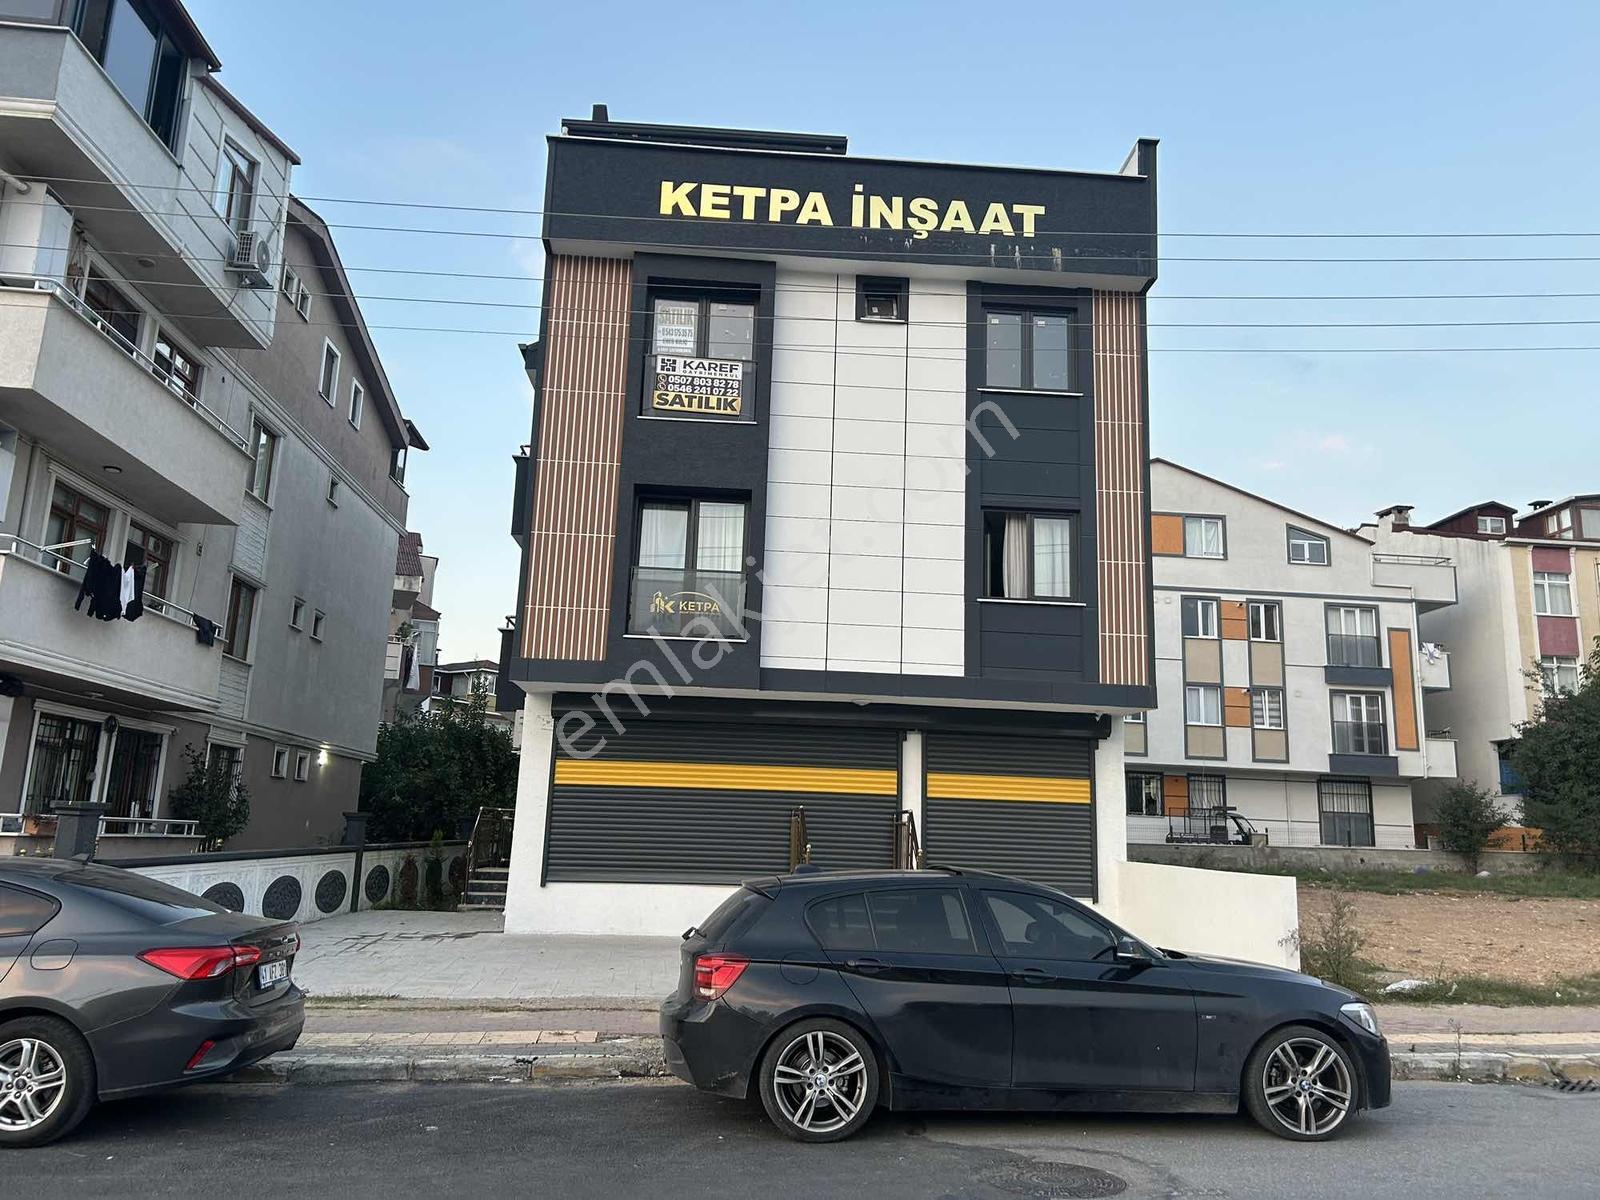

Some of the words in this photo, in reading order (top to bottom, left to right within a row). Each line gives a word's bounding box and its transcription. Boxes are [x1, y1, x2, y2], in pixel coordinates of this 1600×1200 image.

[660, 180, 833, 226] KETPA
[851, 183, 1046, 240] İNŞAAT
[683, 360, 739, 373] KAREF
[668, 375, 691, 384] 0507
[693, 377, 712, 386] 803
[713, 378, 726, 387] 82
[727, 380, 739, 388] 78
[667, 384, 692, 393] 0546
[693, 385, 711, 394] 241
[712, 387, 725, 395] 07
[726, 388, 739, 397] 22
[655, 393, 739, 411] SATILIK
[679, 600, 720, 612] KETPA
